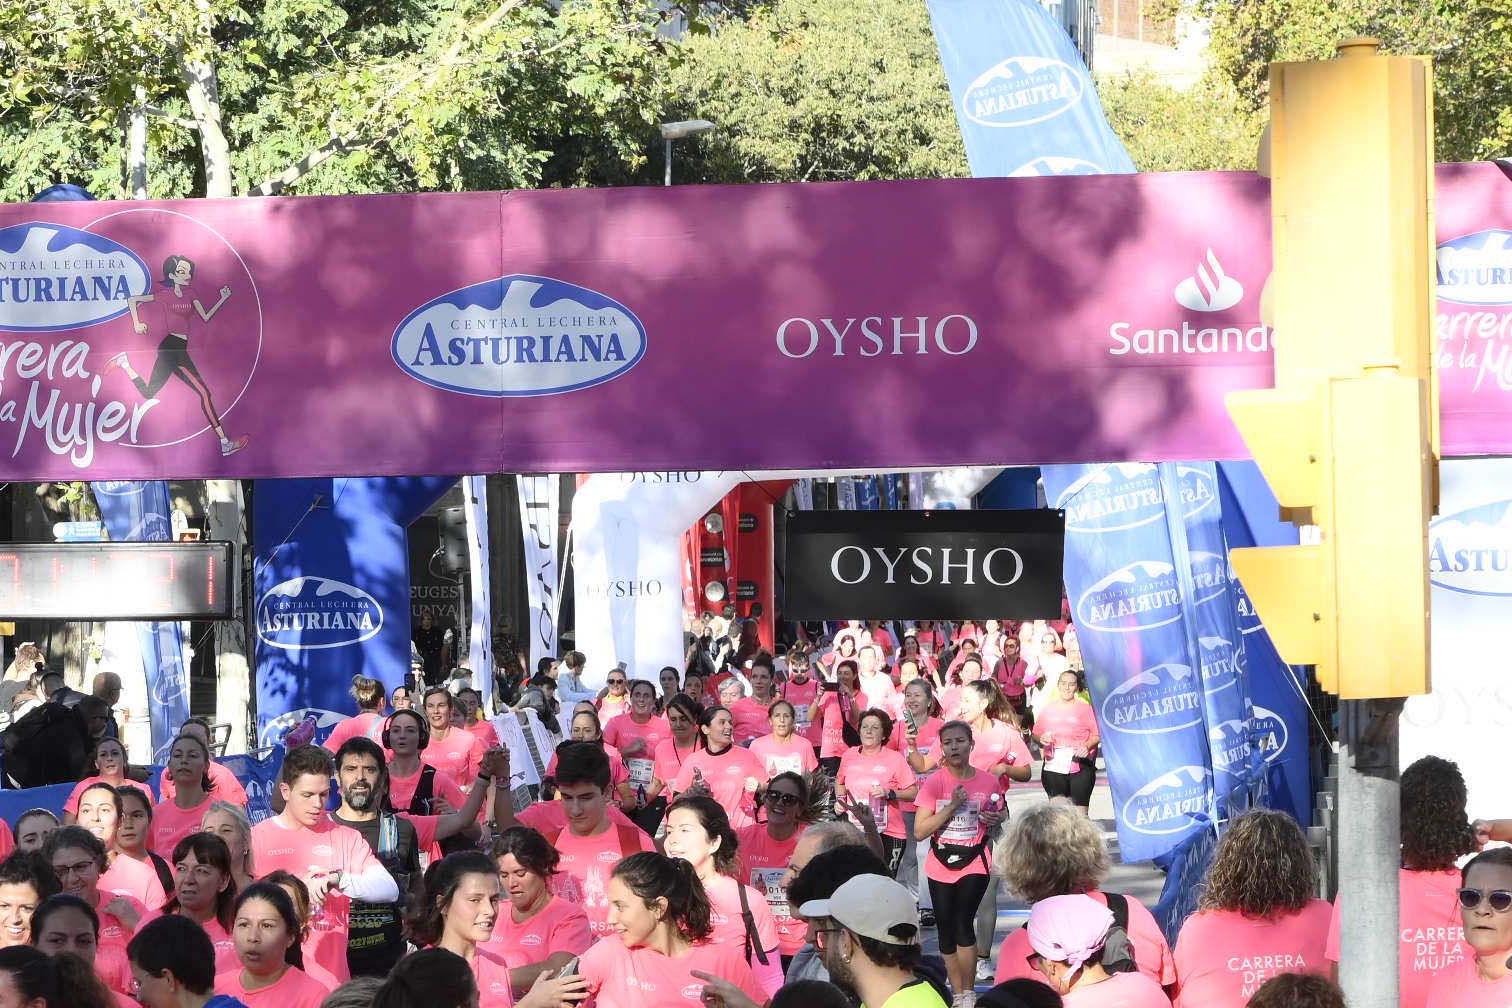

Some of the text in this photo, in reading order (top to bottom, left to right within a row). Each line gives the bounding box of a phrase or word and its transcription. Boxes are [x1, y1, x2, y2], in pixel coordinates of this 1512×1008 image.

[54, 259, 127, 271] LECHERA
[450, 315, 618, 330] CENTRAL LECHERA
[411, 322, 627, 367] ASTURIANA
[776, 313, 978, 359] OYSHO
[11, 373, 161, 468] Mujer
[830, 545, 1024, 586] OYSHO
[1428, 536, 1512, 573] ASTU
[261, 606, 374, 633] ASTURIANA
[1400, 926, 1466, 943] CARRER
[1416, 941, 1463, 956] DE LA
[1227, 953, 1306, 971] CARRERA
[1244, 970, 1265, 984] DE
